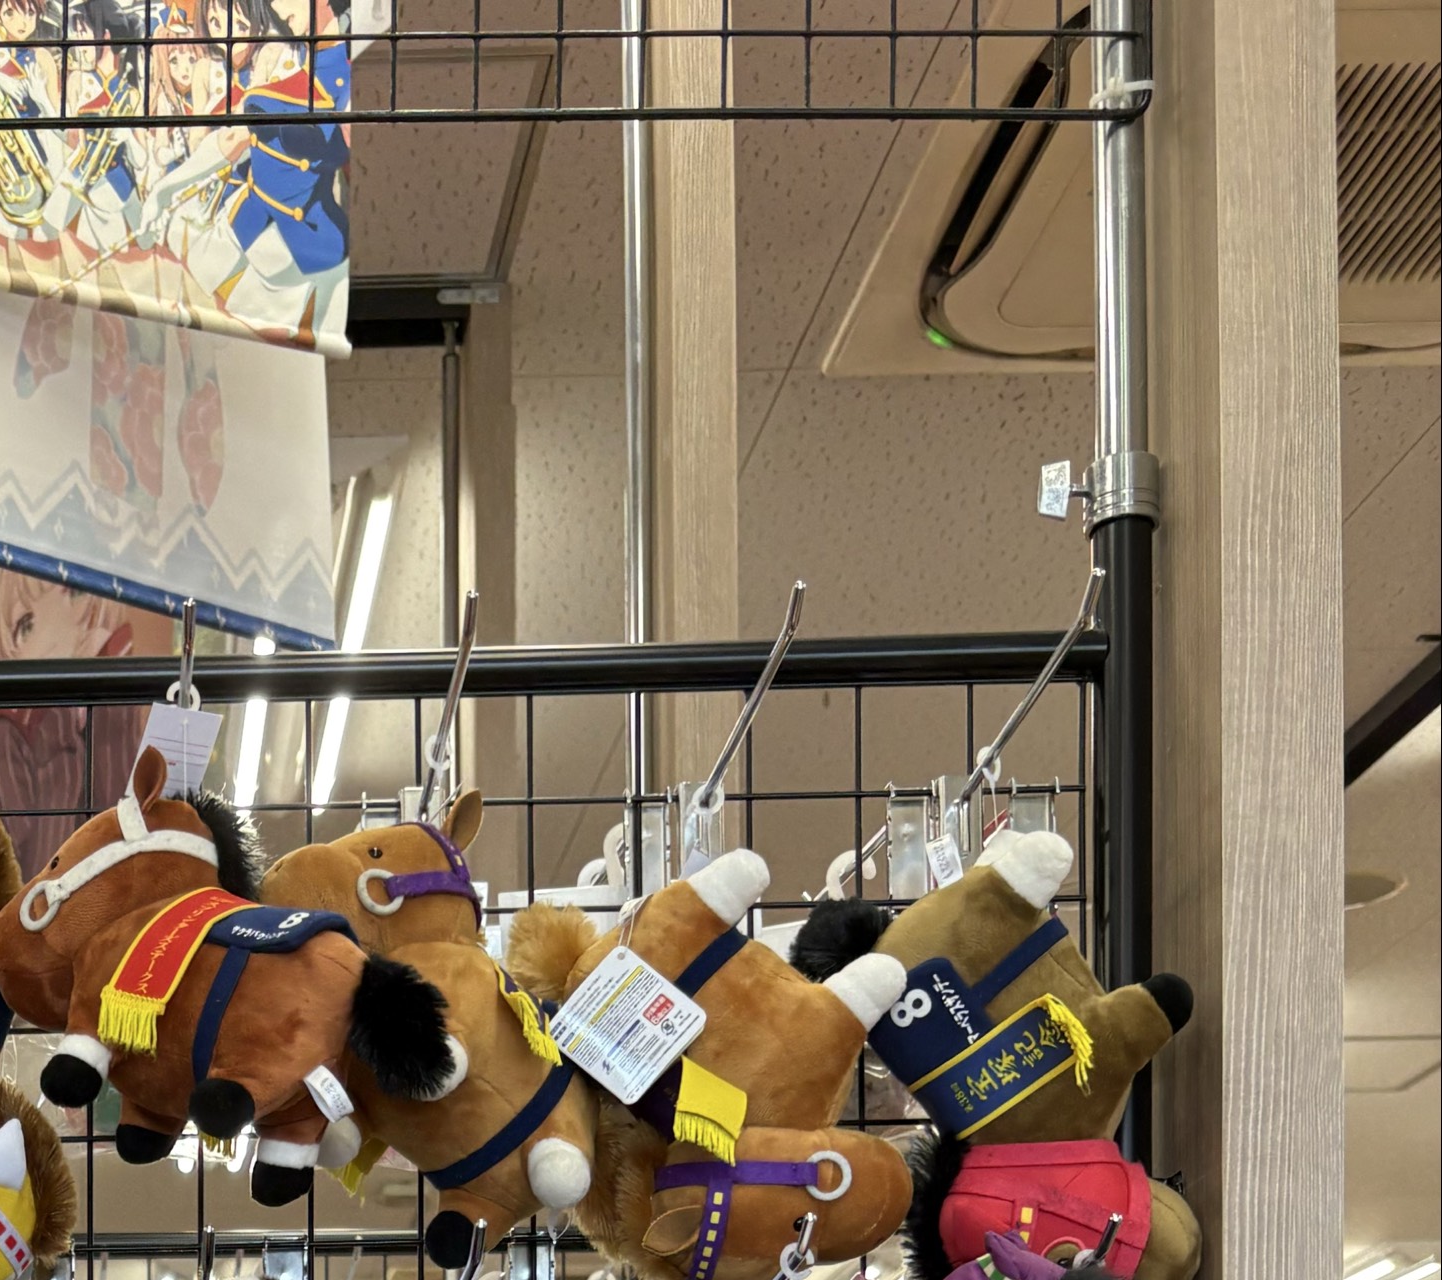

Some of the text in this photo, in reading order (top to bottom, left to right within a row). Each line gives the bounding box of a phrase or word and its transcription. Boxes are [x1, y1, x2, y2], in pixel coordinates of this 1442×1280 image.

[278, 911, 310, 929] 8
[890, 988, 932, 1028] 8
[932, 973, 981, 1045] マーベラスサンデー
[966, 1018, 1066, 1101] 宝塚記念
